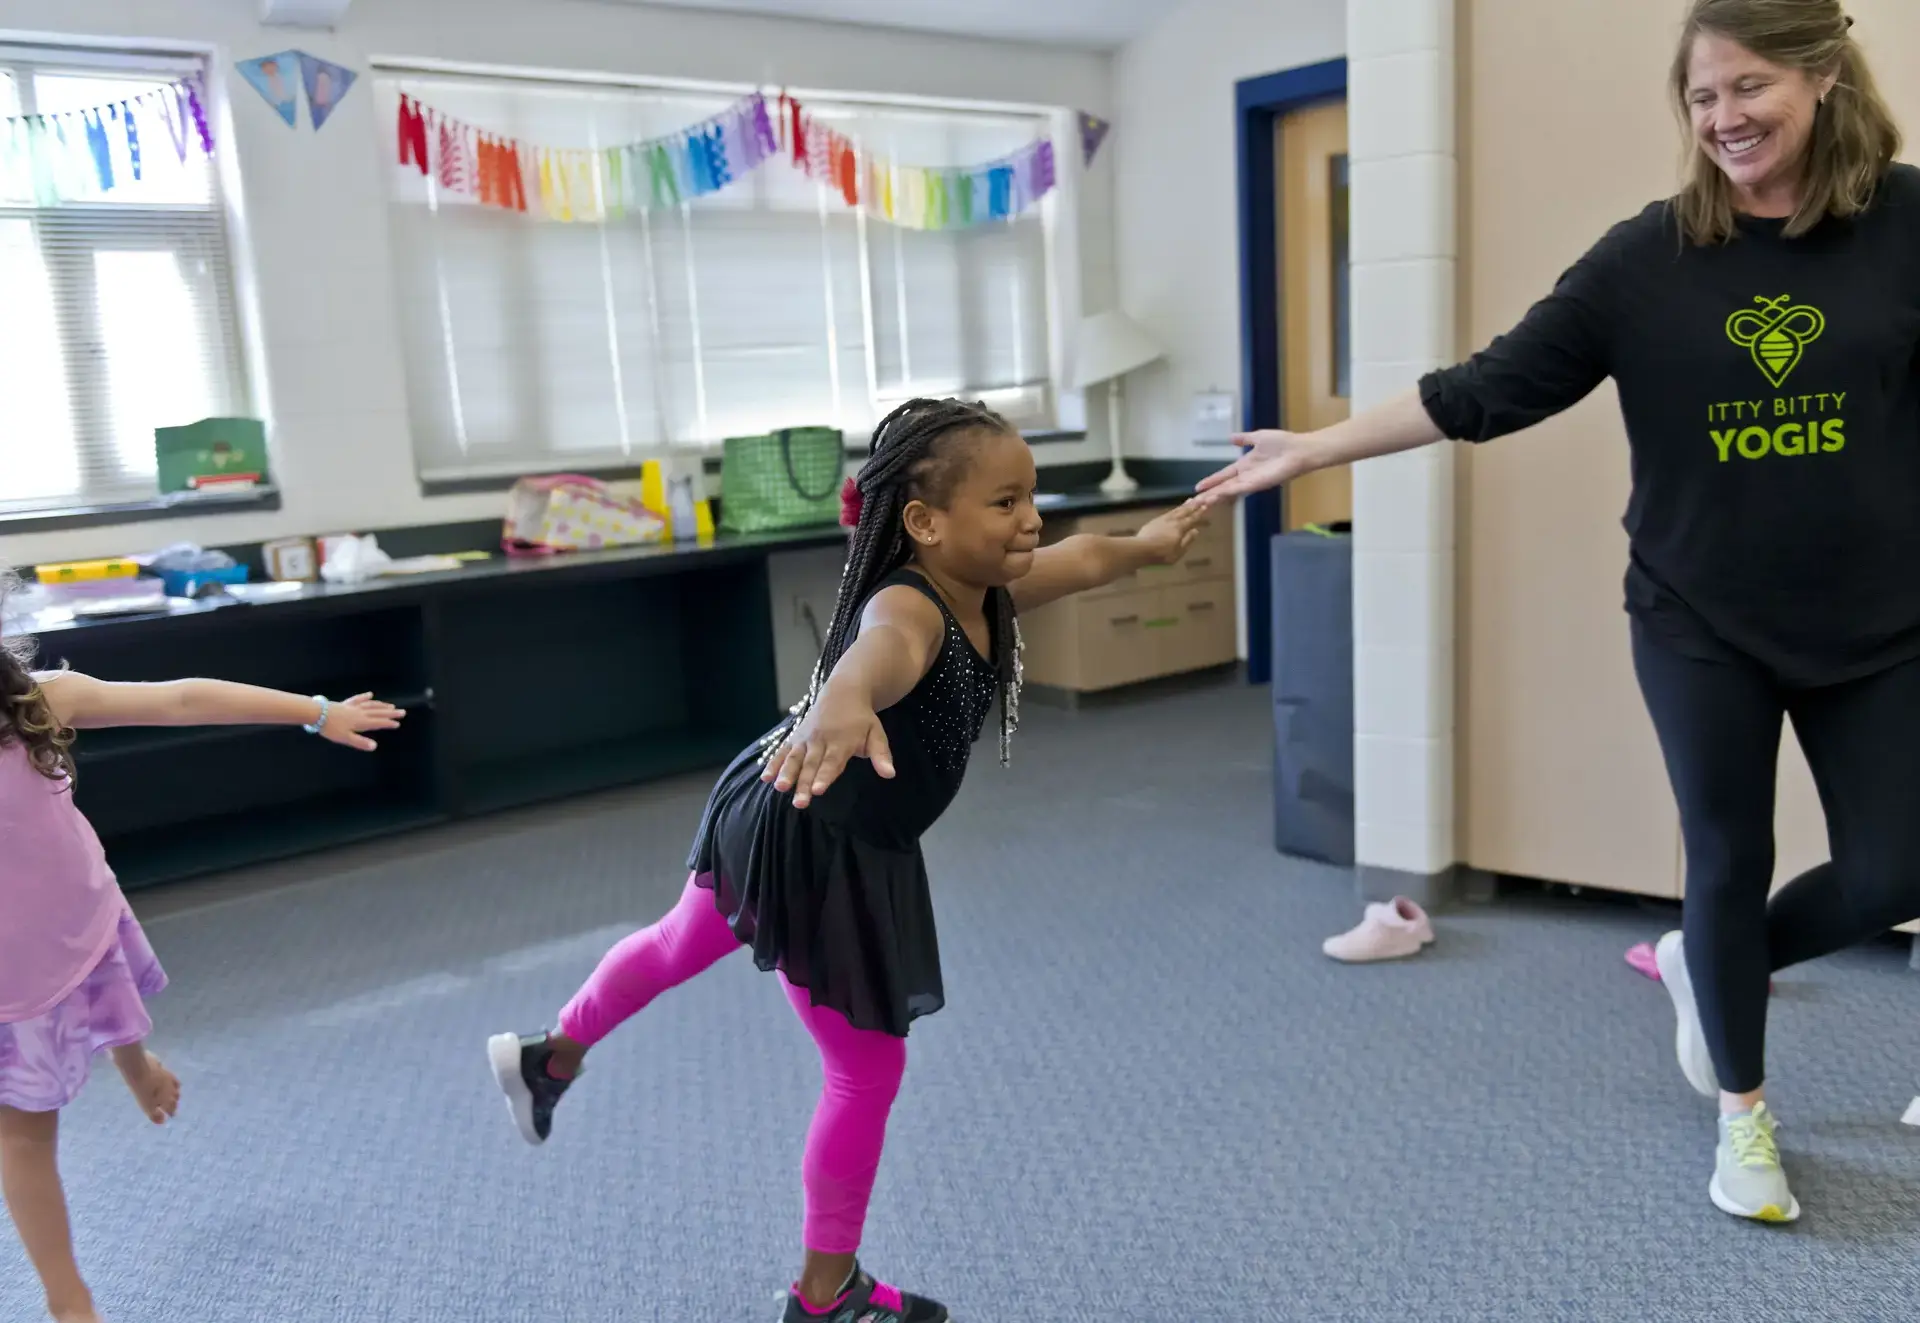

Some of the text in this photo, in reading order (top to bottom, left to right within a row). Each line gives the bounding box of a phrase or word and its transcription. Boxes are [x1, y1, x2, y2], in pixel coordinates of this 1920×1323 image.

[1708, 392, 1847, 422] ITTY BITTY
[1709, 418, 1845, 462] YOGIS
